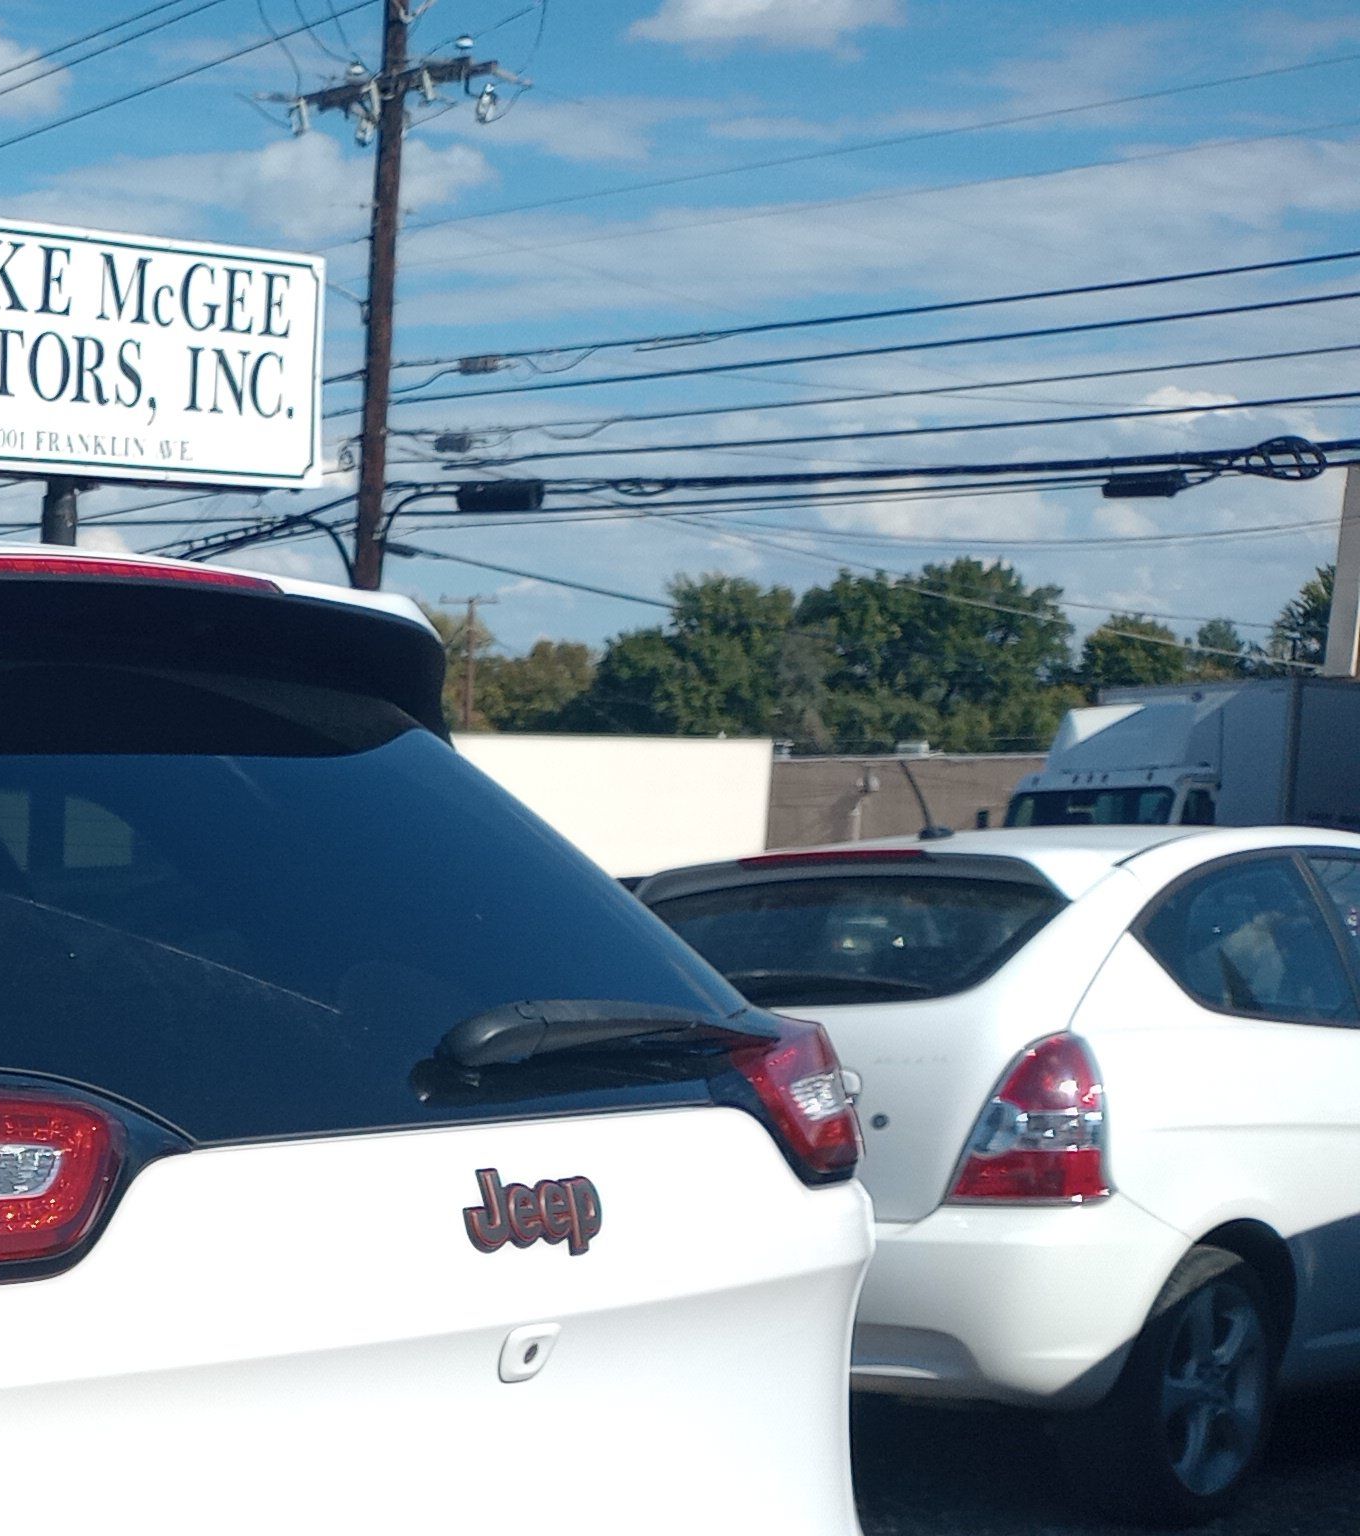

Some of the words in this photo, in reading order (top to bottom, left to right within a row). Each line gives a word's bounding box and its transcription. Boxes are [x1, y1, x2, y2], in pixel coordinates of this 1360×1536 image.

[96, 252, 291, 339] McGEE
[184, 346, 294, 419] INC.
[36, 431, 146, 457] FRANKLIN
[158, 440, 194, 461] AVE
[463, 1168, 602, 1256] Jeep
